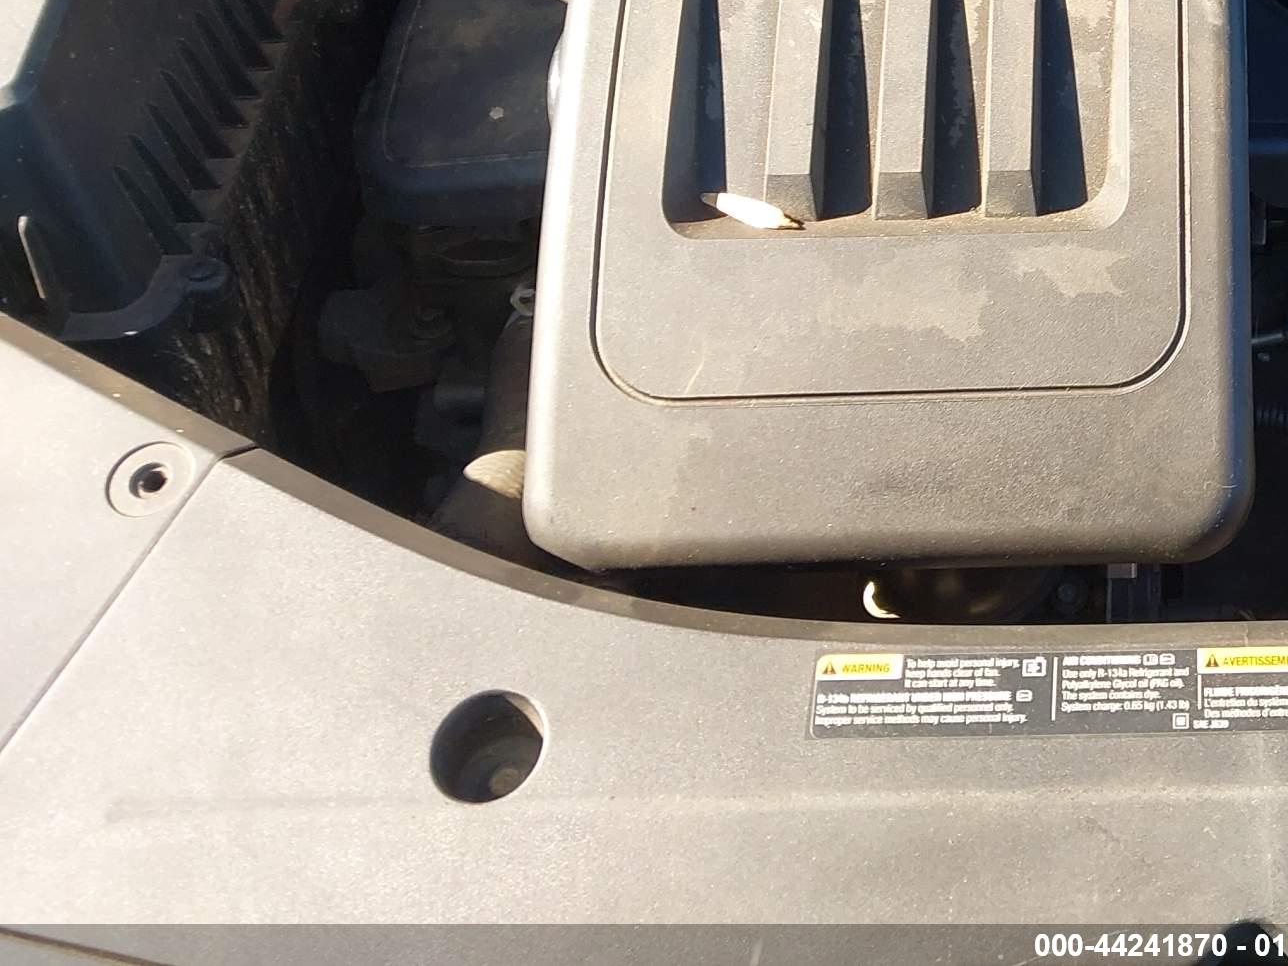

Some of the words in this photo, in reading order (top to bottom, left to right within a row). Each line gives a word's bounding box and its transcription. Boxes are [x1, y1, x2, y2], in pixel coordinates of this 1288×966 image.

[842, 663, 891, 673] WARNING
[1062, 669, 1078, 678] Use
[1079, 669, 1097, 679] only
[1098, 668, 1127, 677] R-134a
[1128, 667, 1172, 678] Refrigerant
[1174, 667, 1190, 676] and
[1062, 691, 1077, 700] The
[1078, 691, 1107, 701] system
[1108, 690, 1143, 700] contains
[1144, 690, 1161, 700] dye.
